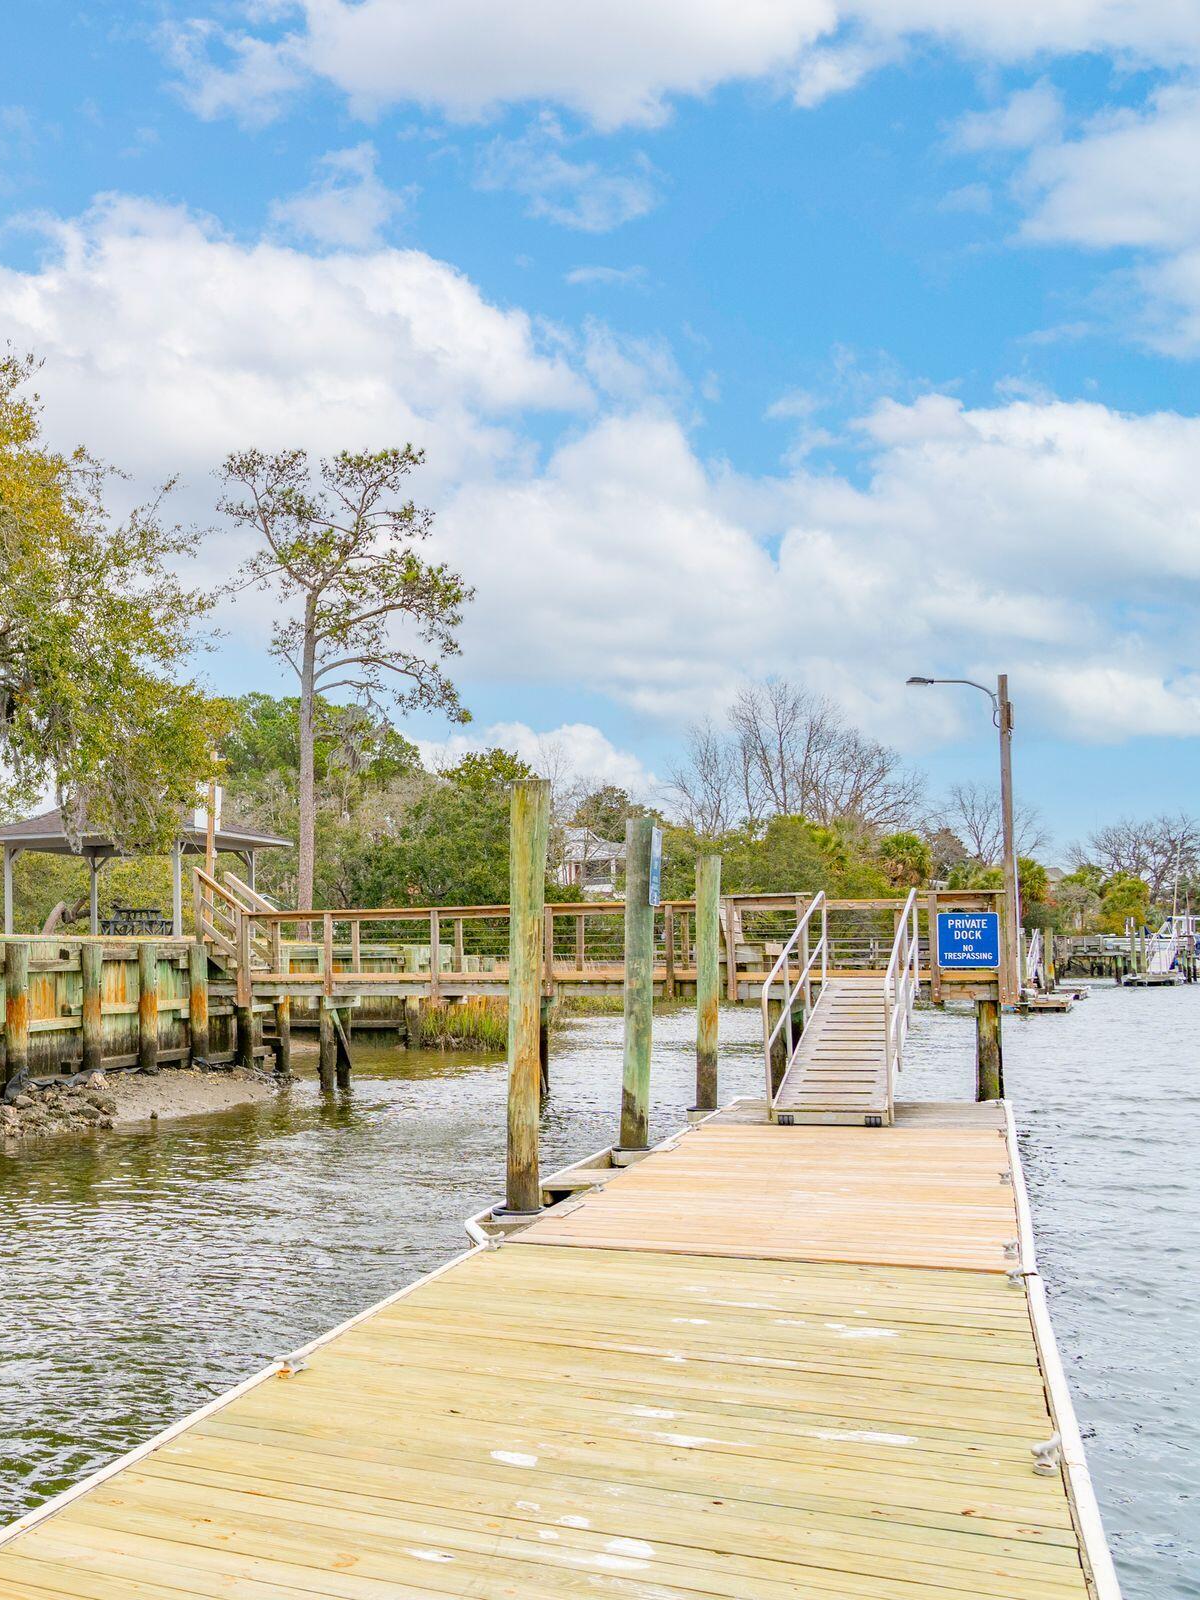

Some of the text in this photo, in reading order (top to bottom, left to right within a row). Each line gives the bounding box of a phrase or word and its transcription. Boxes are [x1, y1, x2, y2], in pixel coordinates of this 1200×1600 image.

[947, 919, 988, 929] PRIVATE
[954, 930, 982, 940] DOCK
[962, 944, 974, 952] NO
[944, 952, 993, 960] TRESPASSING
